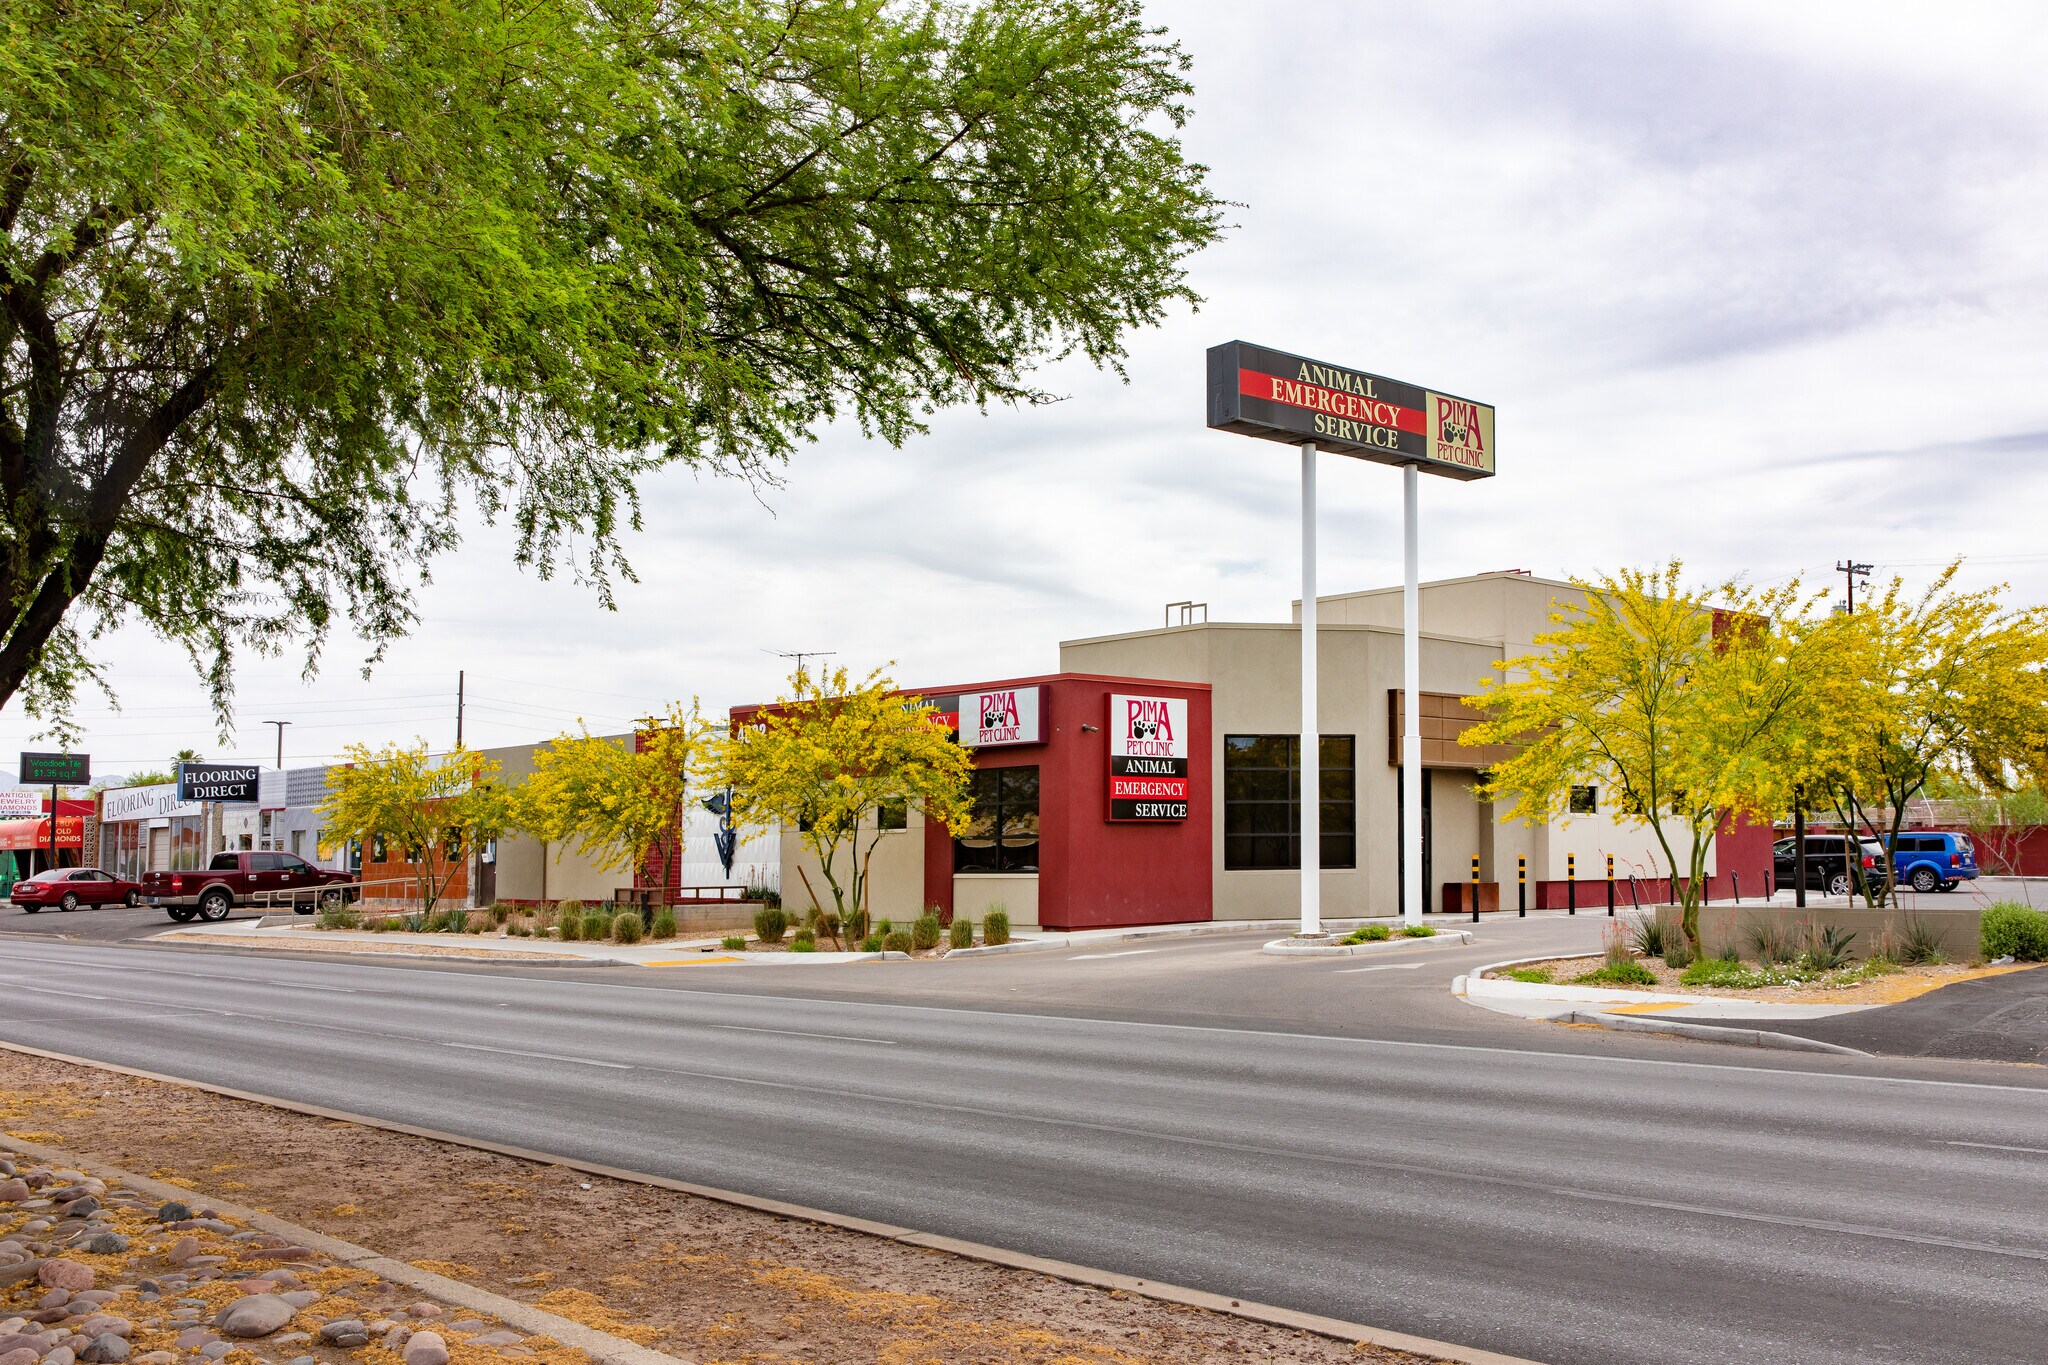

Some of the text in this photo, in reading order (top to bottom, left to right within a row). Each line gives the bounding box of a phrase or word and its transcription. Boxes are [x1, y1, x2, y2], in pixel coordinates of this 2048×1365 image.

[1297, 362, 1377, 398] ANIMAL
[1271, 377, 1400, 427] EMERGENCY
[1314, 413, 1398, 449] SERVICE
[1436, 397, 1484, 450] PIMA
[1437, 443, 1484, 468] PET CLINIC
[979, 692, 1020, 729] PIMA
[1126, 699, 1174, 740] PIMA
[979, 727, 1020, 742] PET CLINIC
[1126, 741, 1174, 756] PET CLINIC
[30, 759, 81, 768] Woodlook Tile
[1125, 760, 1175, 774] ANIMAL
[33, 769, 57, 777] $1.35
[184, 769, 257, 784] FLOORING
[193, 784, 247, 799] DIRECT
[1115, 781, 1184, 796] EMERGENCY
[107, 788, 195, 818] FLOORING DIR
[1135, 803, 1187, 817] SERVICE
